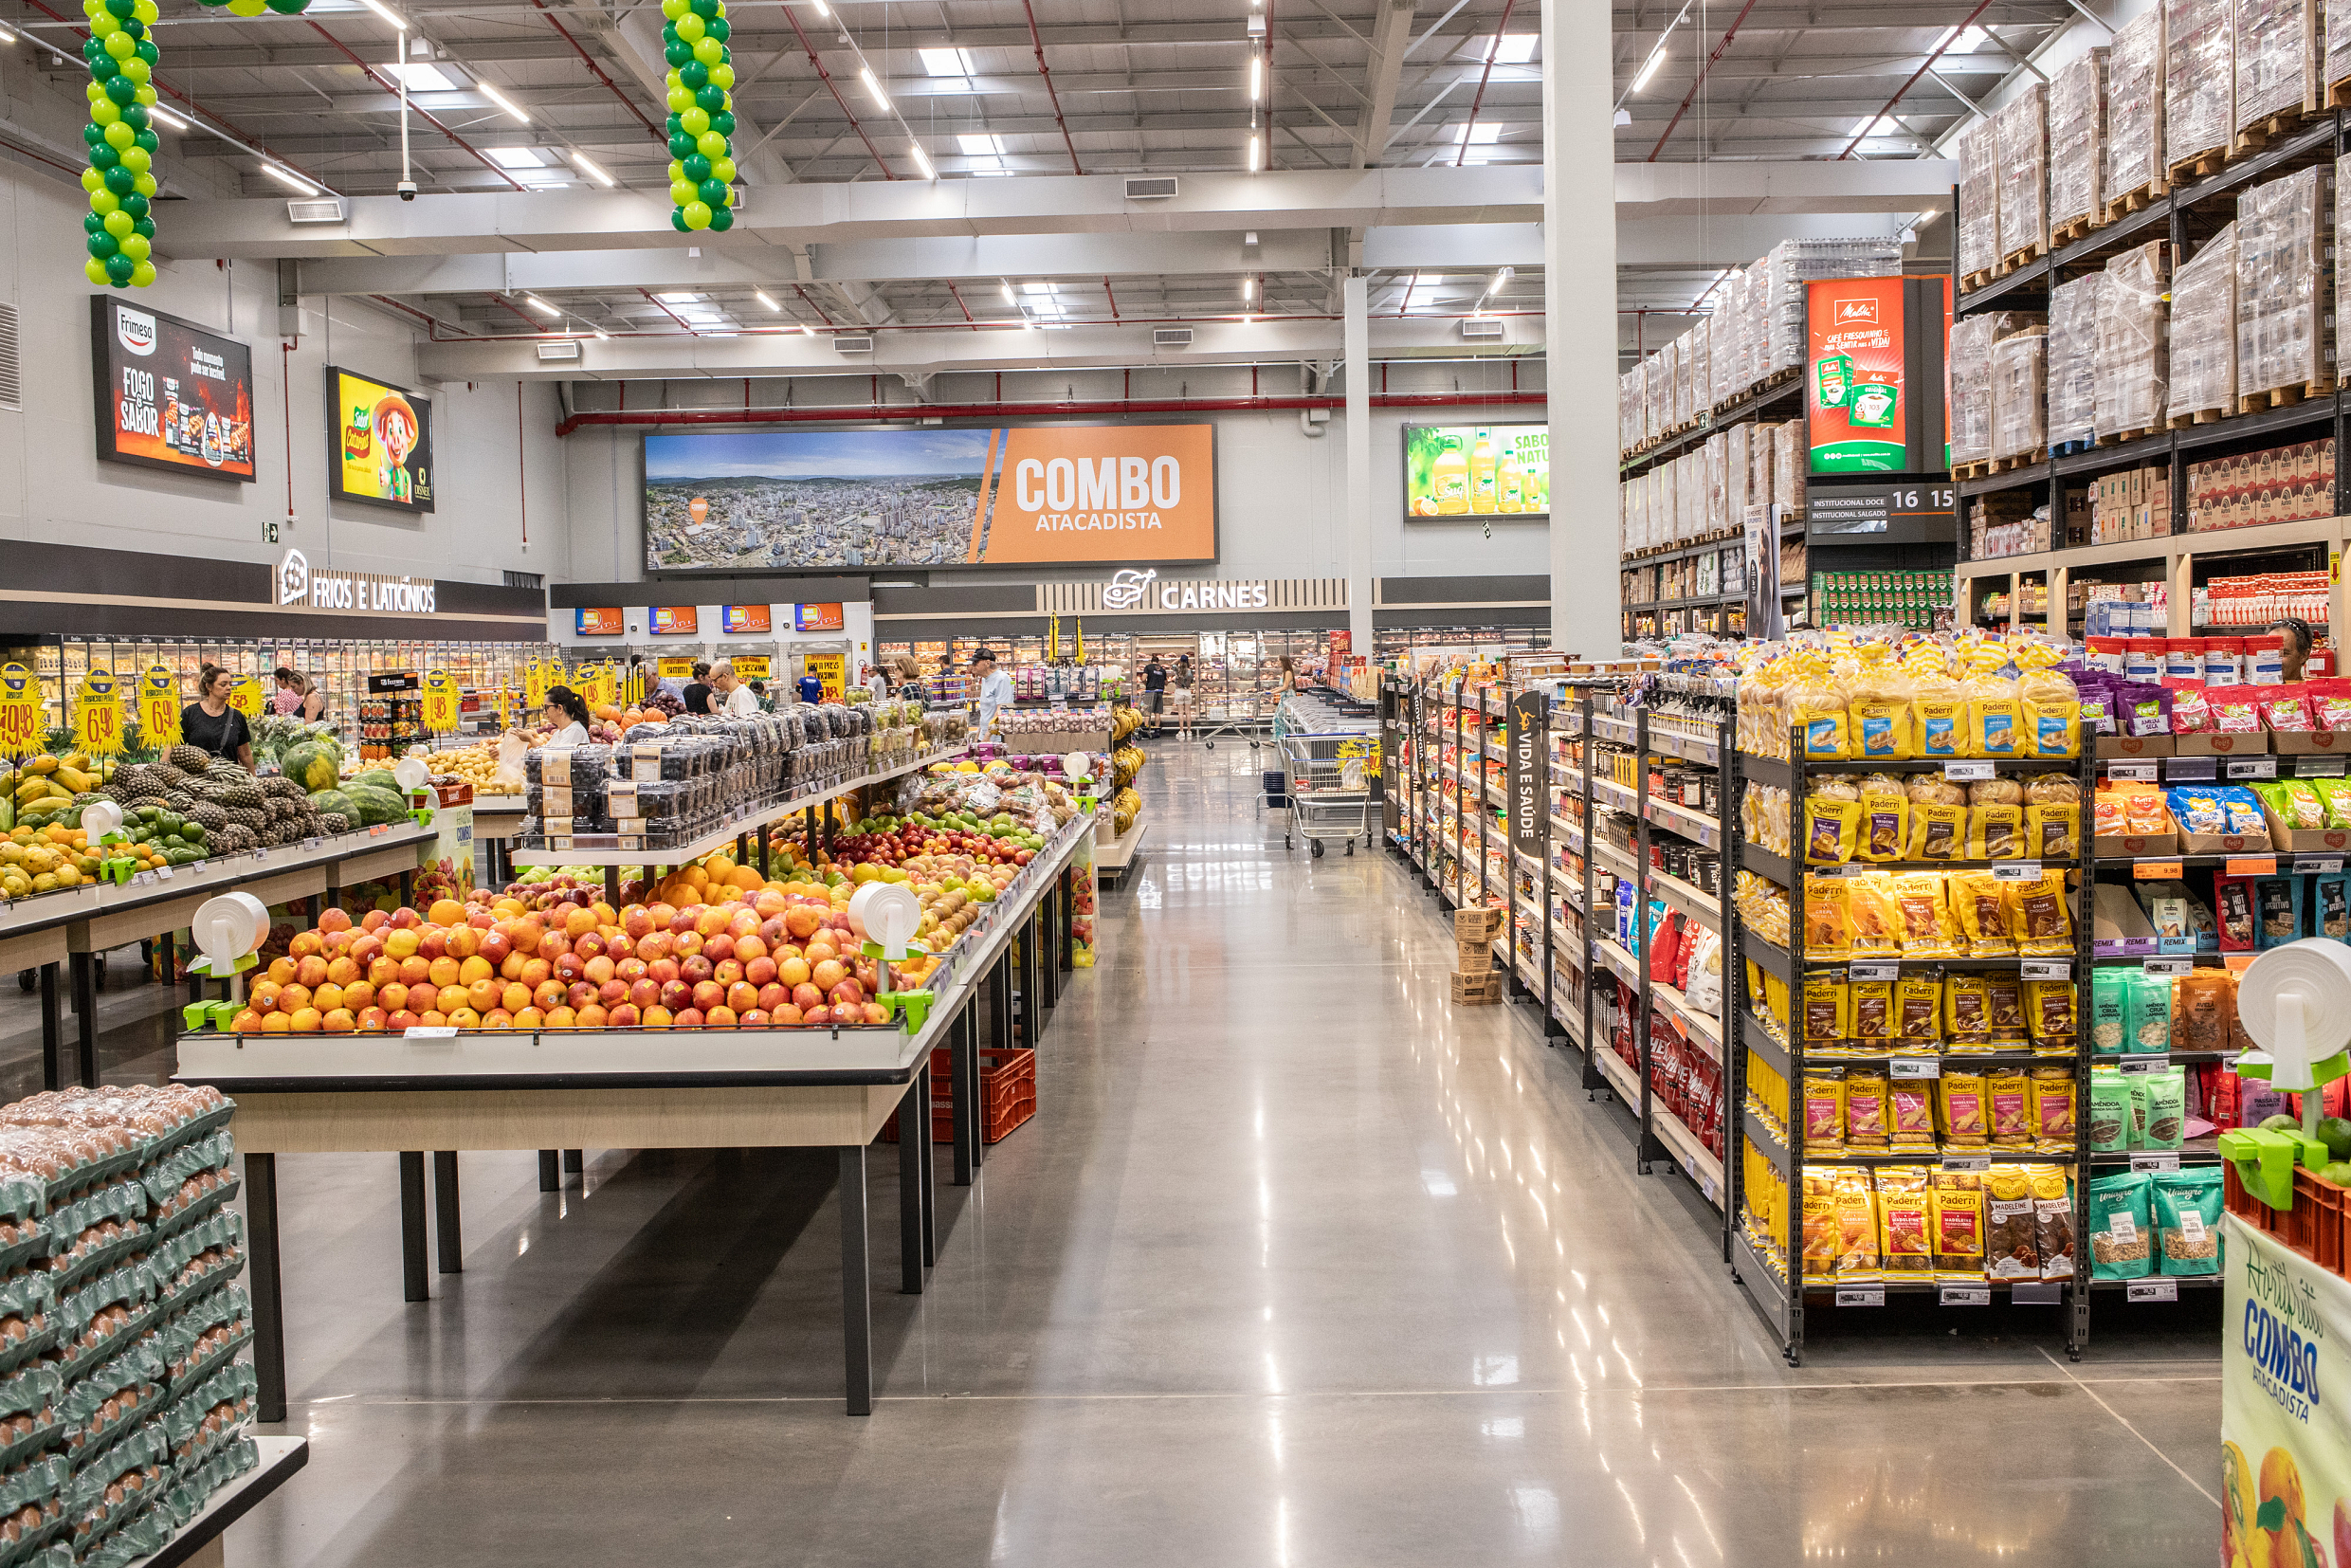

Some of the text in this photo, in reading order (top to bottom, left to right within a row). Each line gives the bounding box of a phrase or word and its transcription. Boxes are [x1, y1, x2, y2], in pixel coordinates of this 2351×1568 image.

[1839, 303, 1872, 319] Melitta
[120, 314, 153, 339] Frimesa
[1827, 330, 1883, 343] CAFÉ FRESQUINHO
[1835, 339, 1858, 350] SENTIR
[1871, 337, 1890, 347] VIDA!
[191, 346, 203, 362] Todo
[191, 361, 201, 375] pode
[123, 366, 155, 402] FOGO
[137, 393, 142, 409] &
[120, 400, 159, 438] SABOR
[355, 411, 369, 428] Sabor
[1515, 433, 1549, 449] SABO
[1517, 449, 1549, 465] NATU
[1016, 455, 1181, 512] COMBO
[1892, 491, 1919, 508] 16
[1931, 489, 1954, 507] 15
[1035, 512, 1162, 532] ATACADISTA
[313, 575, 436, 613] FRIOS E LATICÍNIOS
[1160, 585, 1268, 609] CARNES
[1924, 705, 1953, 715] Paderri
[1983, 702, 2012, 711] Paderri
[2139, 706, 2157, 715] Feliz
[152, 700, 174, 737] 6,98
[87, 707, 114, 745] 6,98
[1519, 732, 1536, 838] VIDA E SAÚDE
[1870, 800, 1900, 810] Paderri
[2135, 796, 2152, 806] Feliz
[1928, 809, 1956, 818] Paderri
[2040, 808, 2069, 817] Paderri
[2232, 894, 2245, 904] HOT
[2271, 894, 2281, 903] MIX
[2233, 904, 2247, 916] MIX
[2266, 901, 2289, 910] APERITIVO
[2125, 938, 2148, 946] REMIX
[1807, 989, 1837, 997] Paderri
[1850, 1085, 1881, 1094] Paderri
[1947, 1081, 1977, 1090] Paderri
[1993, 1081, 2023, 1090] Paderri
[2040, 1083, 2070, 1092] Paderri
[2154, 1098, 2180, 1106] AMÊNDOA
[1941, 1194, 1976, 1205] Paderri
[2099, 1190, 2134, 1202] Uniagro
[2167, 1188, 2203, 1200] Uniagro
[1803, 1201, 1830, 1210] aderri
[1995, 1202, 2027, 1211] MADELEINE
[2040, 1201, 2069, 1210] MADELEINE
[2247, 1239, 2323, 1339] Hortifruti
[2244, 1298, 2321, 1406] COMBO
[2252, 1363, 2309, 1425] ATACADISTA
